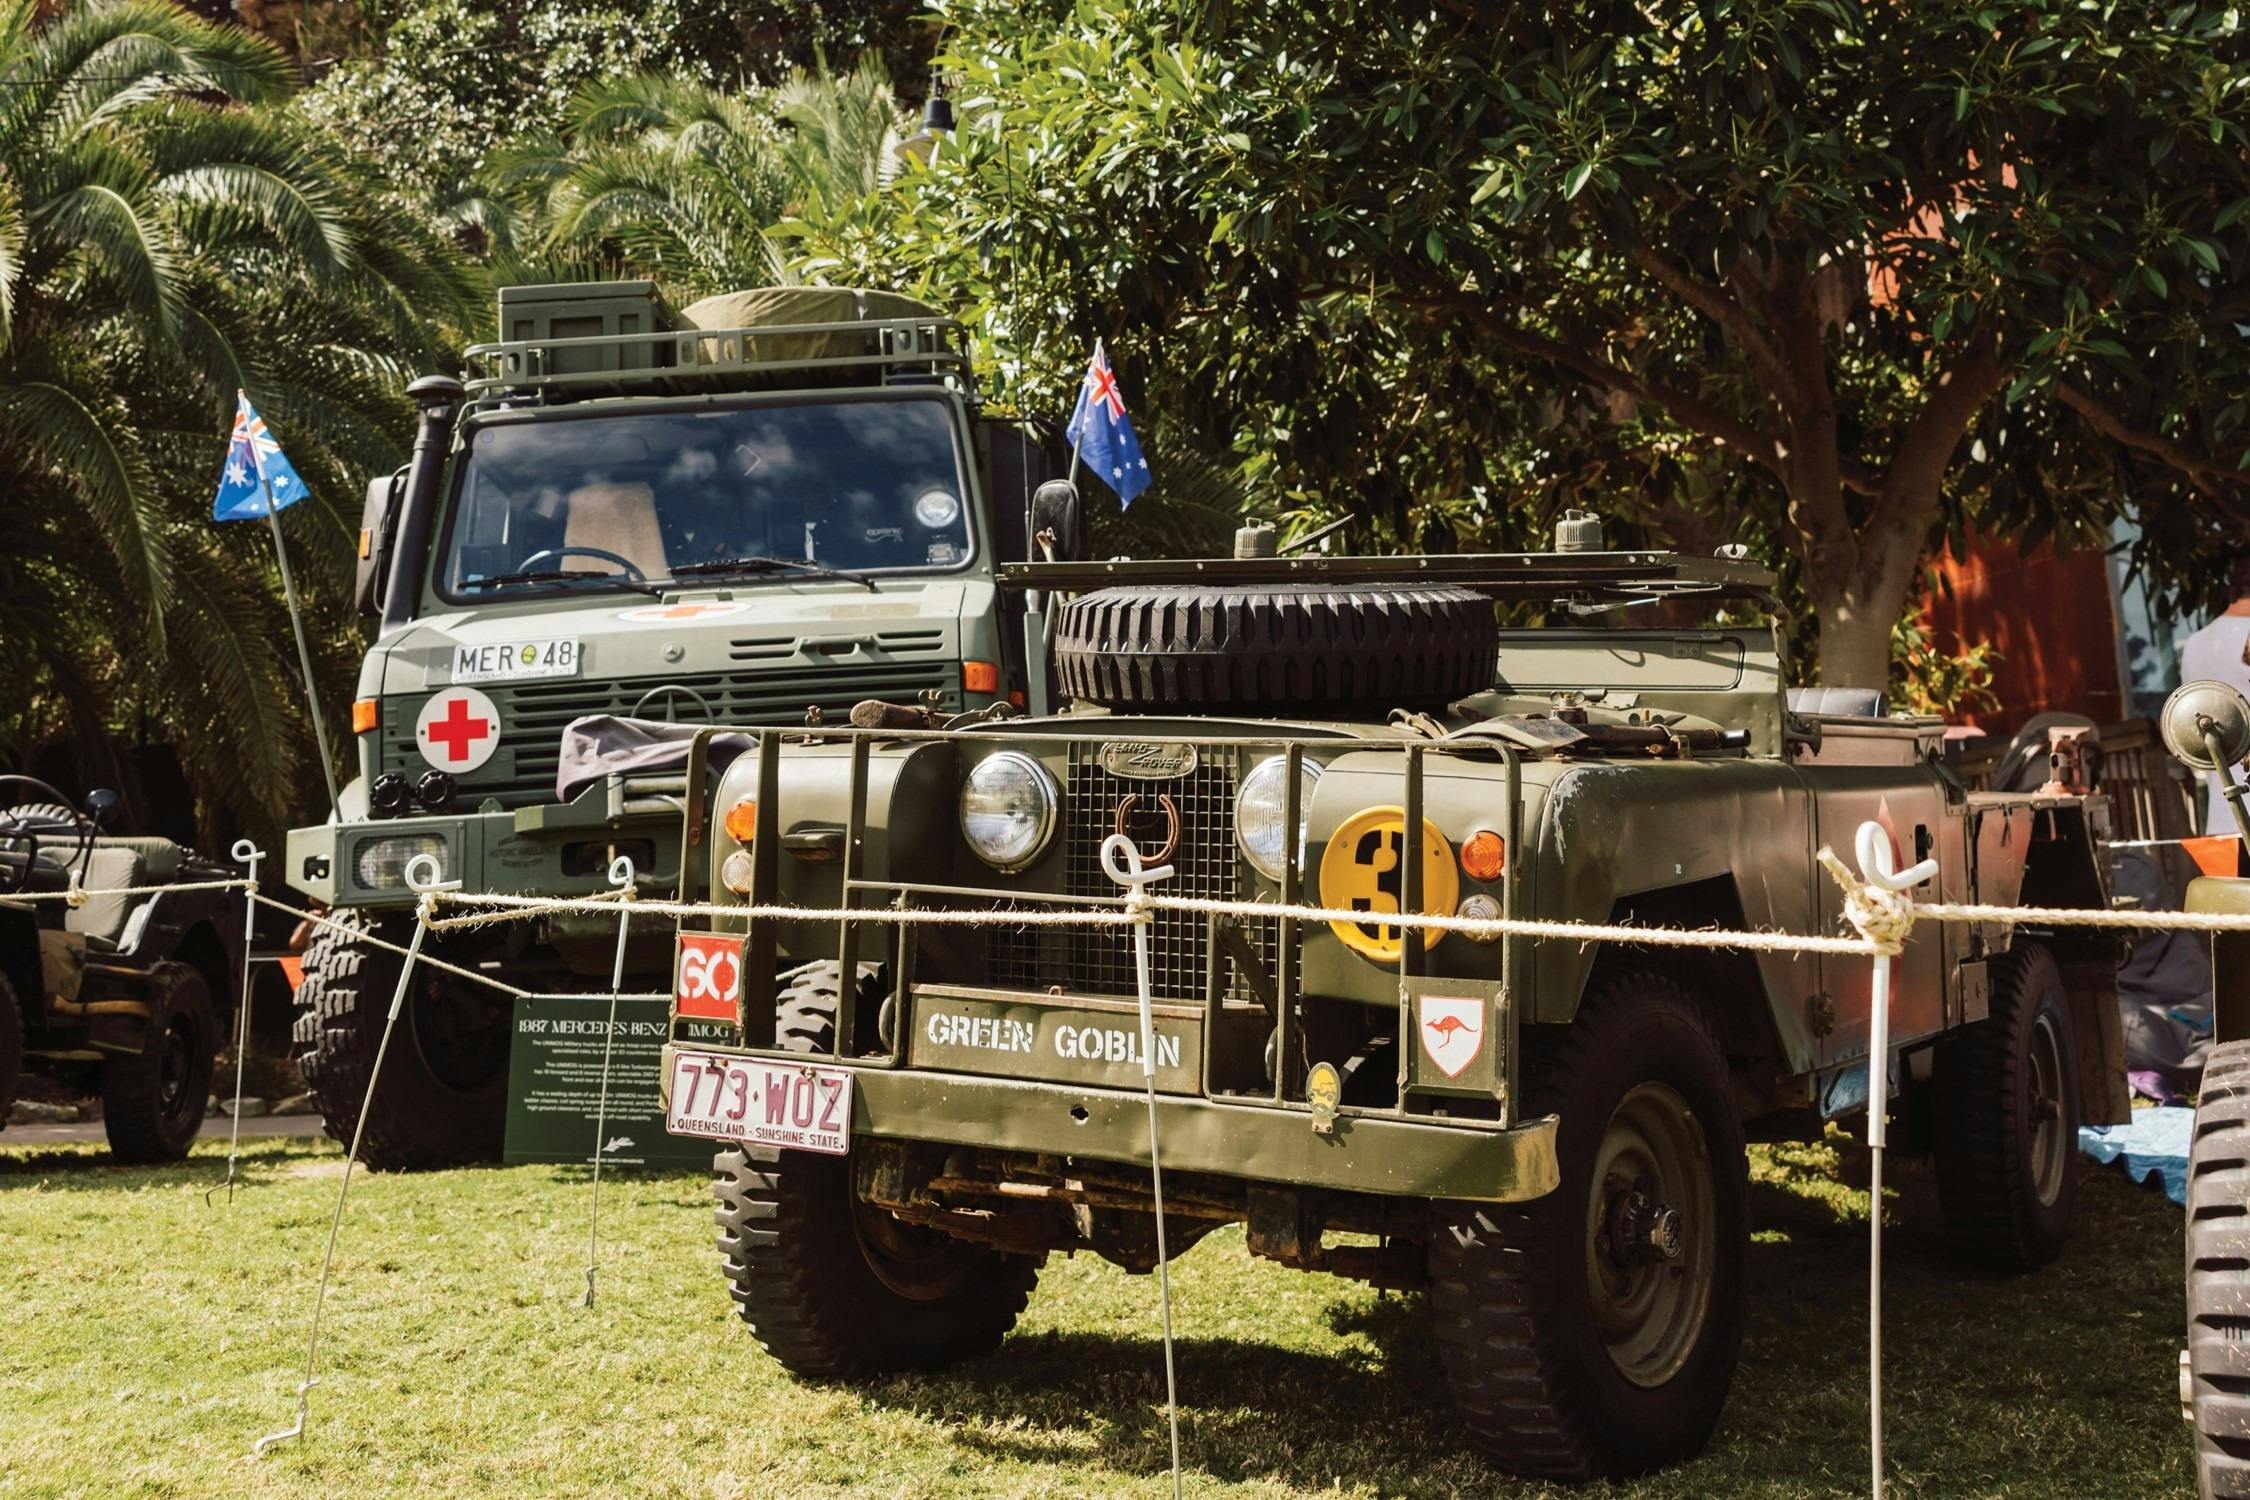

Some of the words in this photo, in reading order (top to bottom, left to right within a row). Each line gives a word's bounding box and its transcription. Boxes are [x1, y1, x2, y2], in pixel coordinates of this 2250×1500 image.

[459, 645, 514, 673] MER
[542, 641, 573, 666] 48
[1141, 757, 1183, 770] ROVER
[1352, 829, 1412, 940] 3
[679, 947, 741, 1002] 60
[519, 1019, 549, 1034] 1987
[927, 1012, 1033, 1053] GREEN
[1054, 1024, 1180, 1068] GOBLN
[681, 1063, 748, 1120] 773
[765, 1071, 844, 1132] WOZ
[677, 1117, 745, 1136] QUEENSLAND
[755, 1127, 806, 1145] SUNSHINE
[809, 1133, 841, 1148] STATE
